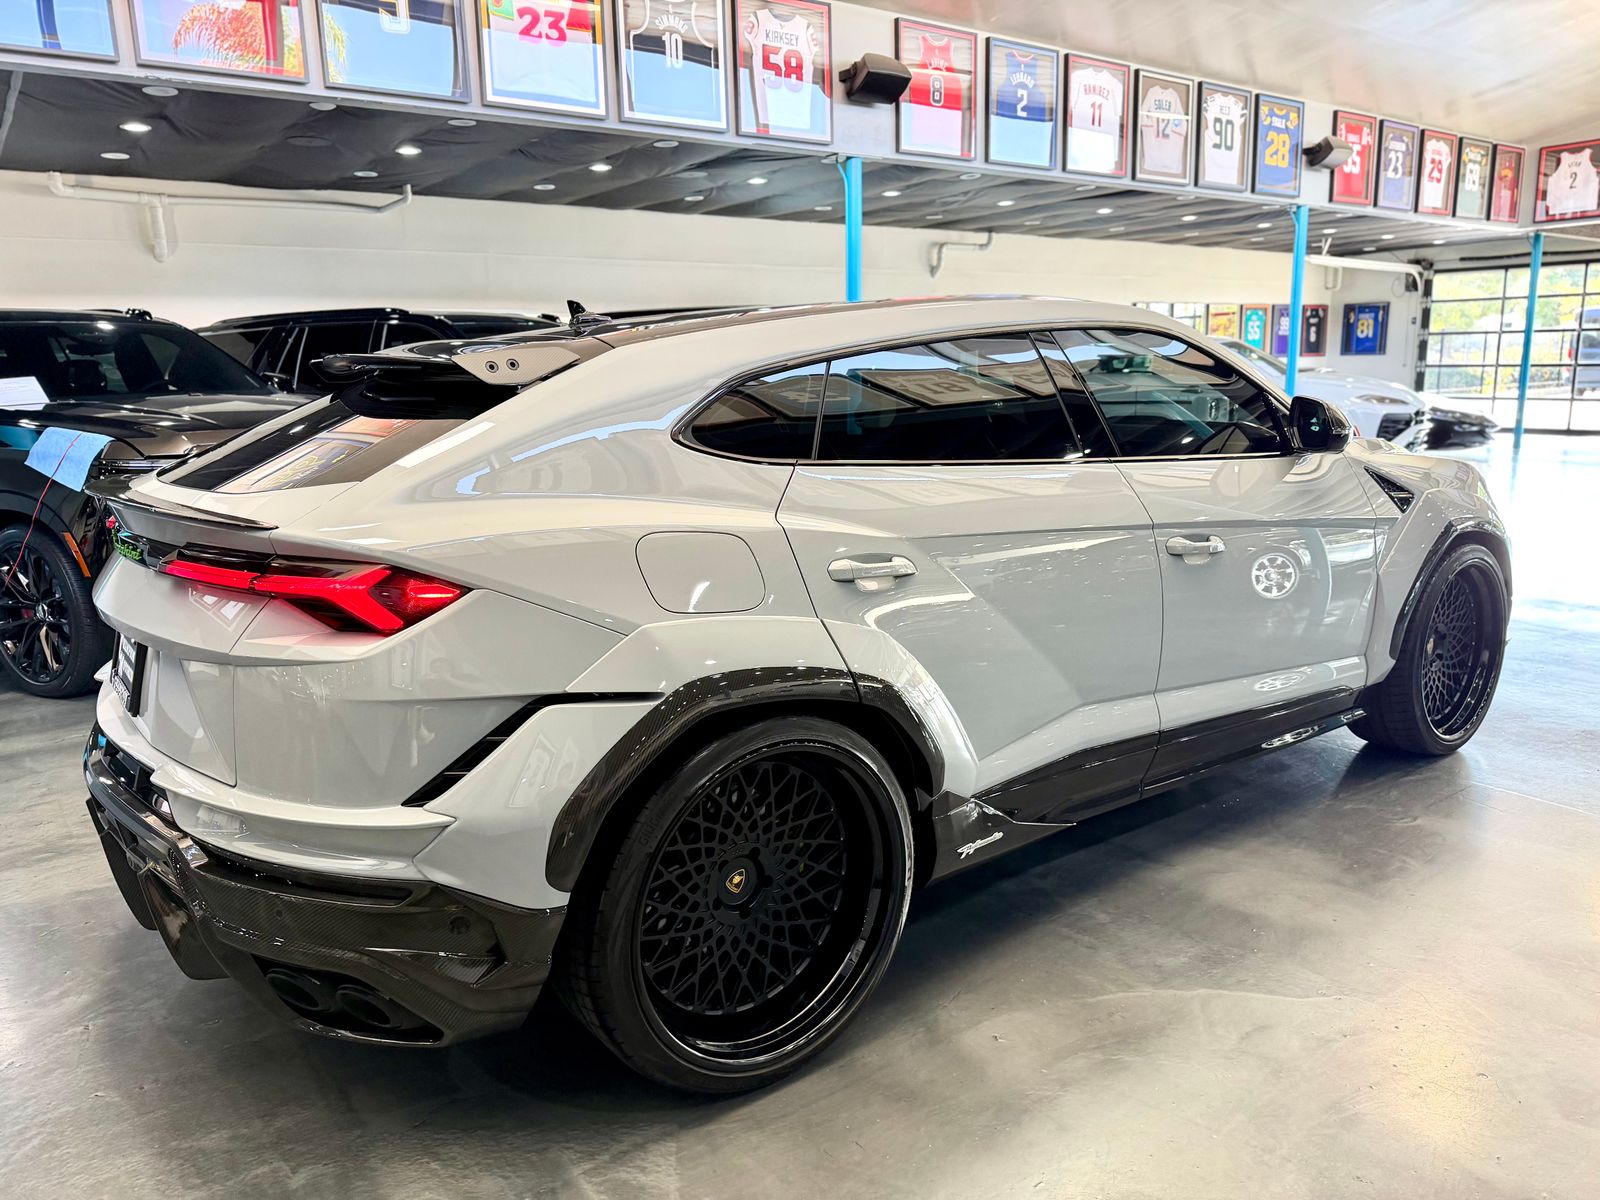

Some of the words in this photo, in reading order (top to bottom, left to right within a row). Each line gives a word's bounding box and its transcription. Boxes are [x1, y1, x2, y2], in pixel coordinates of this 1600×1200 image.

[516, 6, 567, 47] 23
[765, 29, 799, 47] KIRKSEY
[662, 31, 684, 69] 10
[762, 43, 804, 93] 58
[930, 75, 944, 106] 8
[1016, 88, 1028, 117] 2
[1090, 101, 1103, 128] 11
[1155, 116, 1170, 139] 12
[1212, 116, 1234, 152] 90
[1264, 130, 1291, 168] 28
[1386, 150, 1403, 179] 23
[1427, 157, 1443, 184] 29
[1569, 171, 1578, 190] 2
[1247, 320, 1261, 341] 55
[1357, 318, 1374, 339] 81
